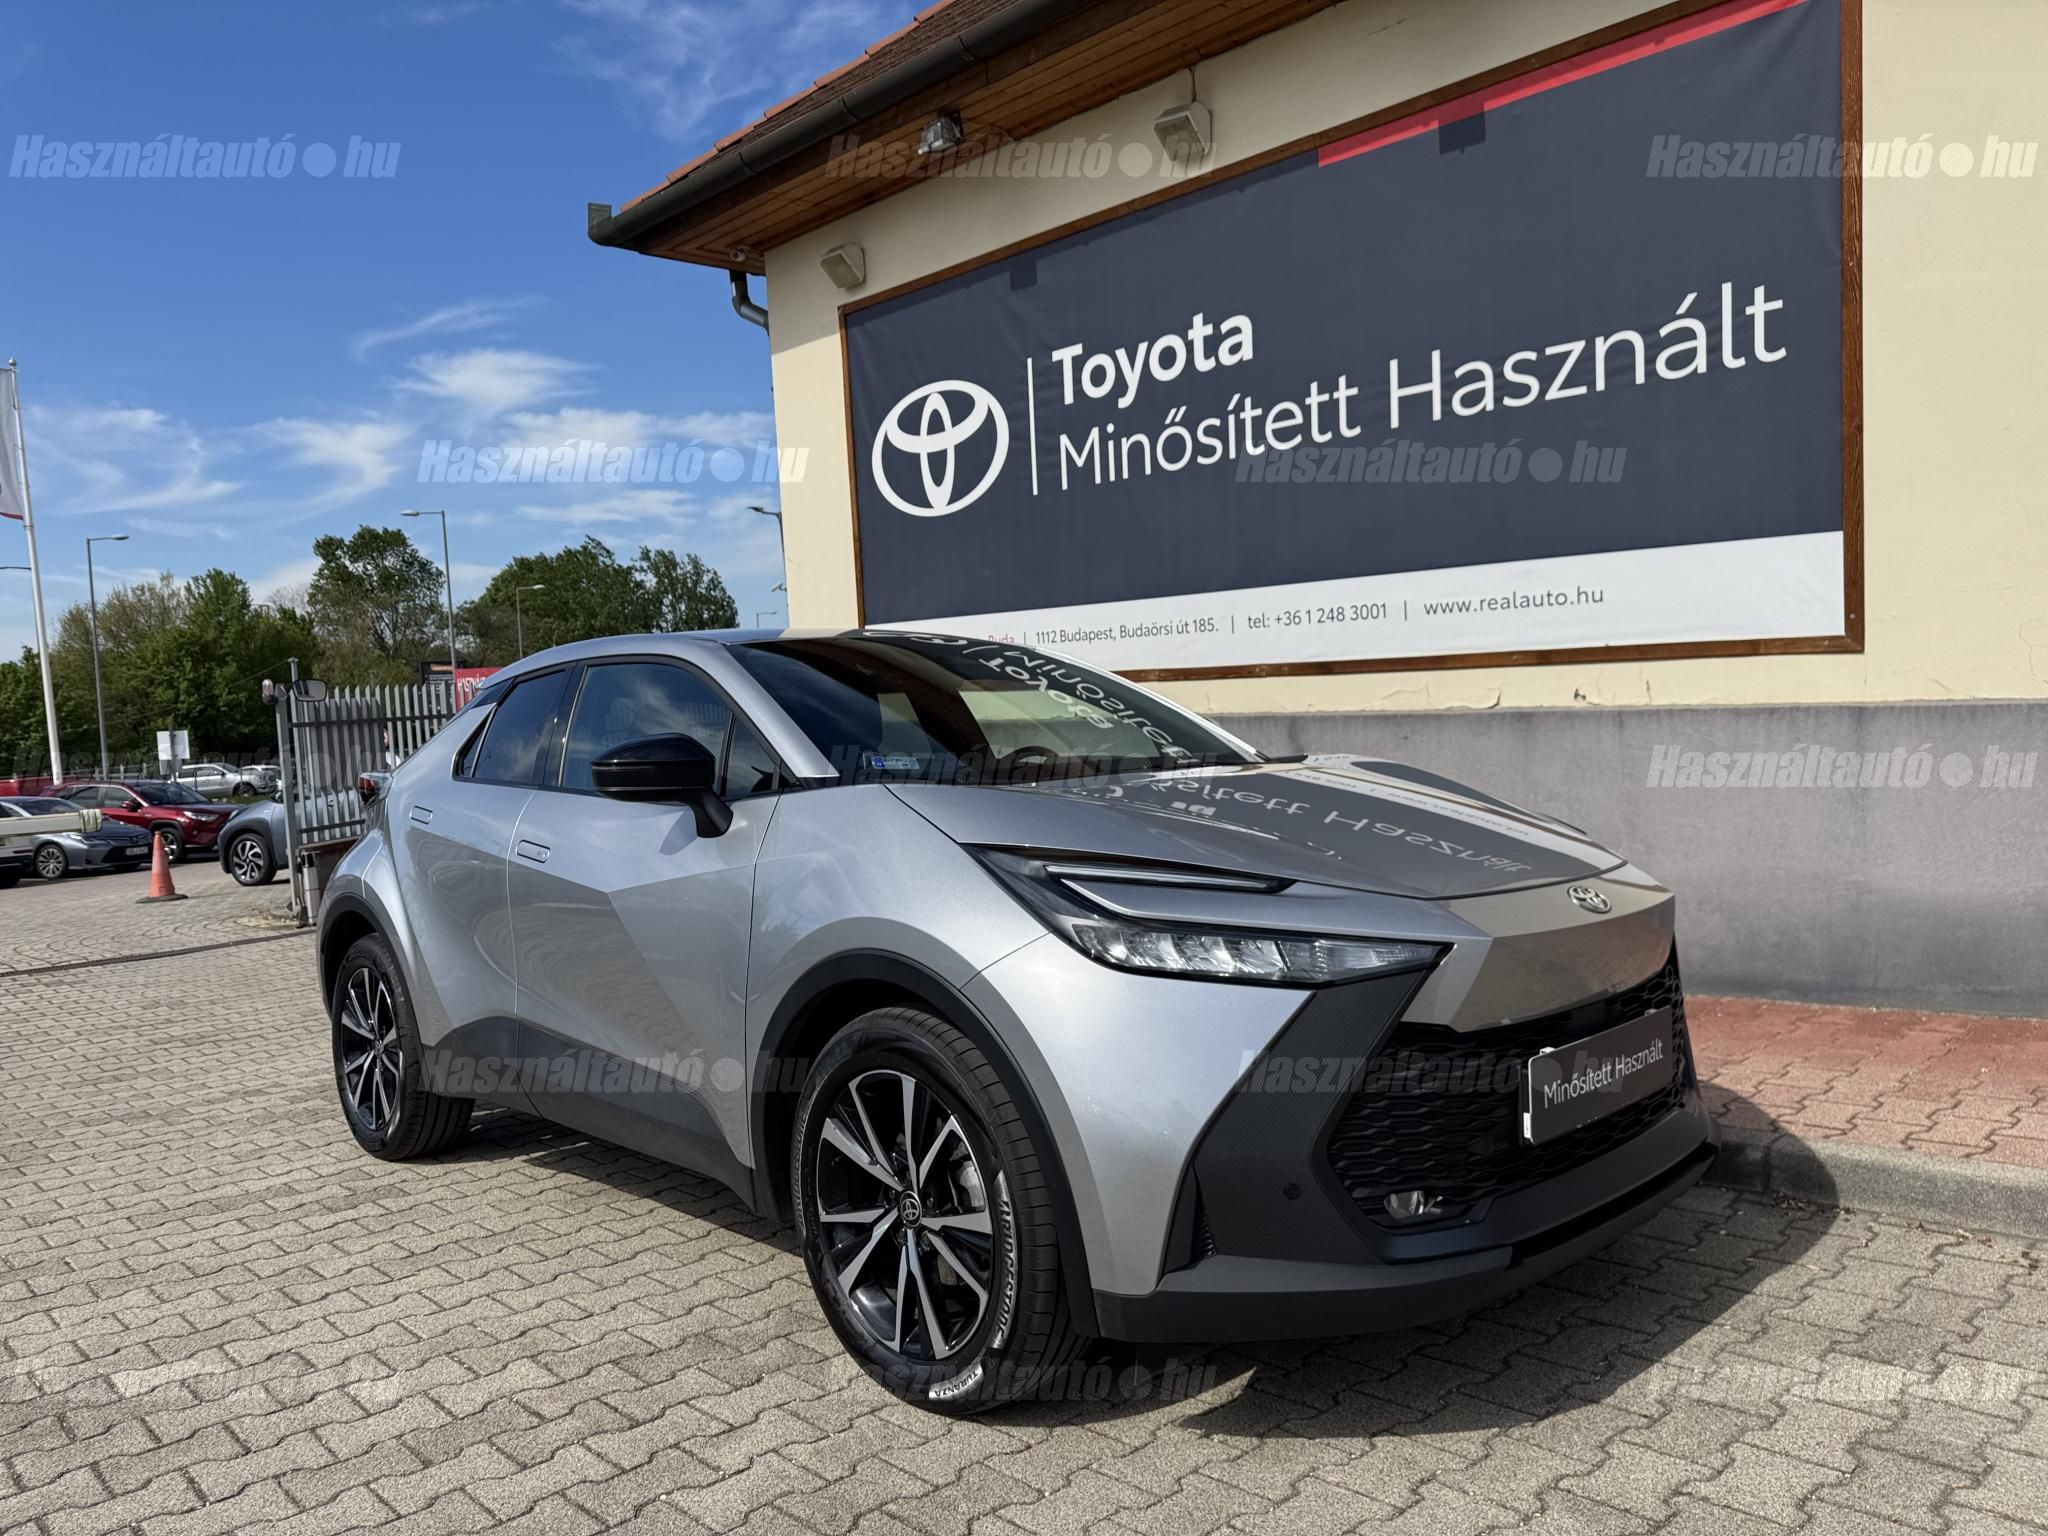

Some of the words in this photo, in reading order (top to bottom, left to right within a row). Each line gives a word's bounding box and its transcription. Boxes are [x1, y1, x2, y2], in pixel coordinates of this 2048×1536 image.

[1052, 312, 1254, 409] Toyota
[1059, 374, 1362, 490] Minősített
[1389, 281, 1787, 429] Használt
[1036, 630, 1057, 645] 1112
[1059, 627, 1117, 644] Budapest,
[1119, 619, 1173, 639] Budaörsi
[1176, 618, 1190, 635] út
[1192, 616, 1219, 633] 185.
[1248, 612, 1270, 629] tel:
[1274, 609, 1302, 626] +36
[1316, 606, 1345, 623] 248
[1349, 602, 1387, 621] 3001
[1423, 585, 1605, 617] www.realauto.hu
[1543, 1063, 1613, 1109] Minősített
[1614, 1038, 1664, 1080] Használt
[934, 1369, 979, 1398] TURANZA
